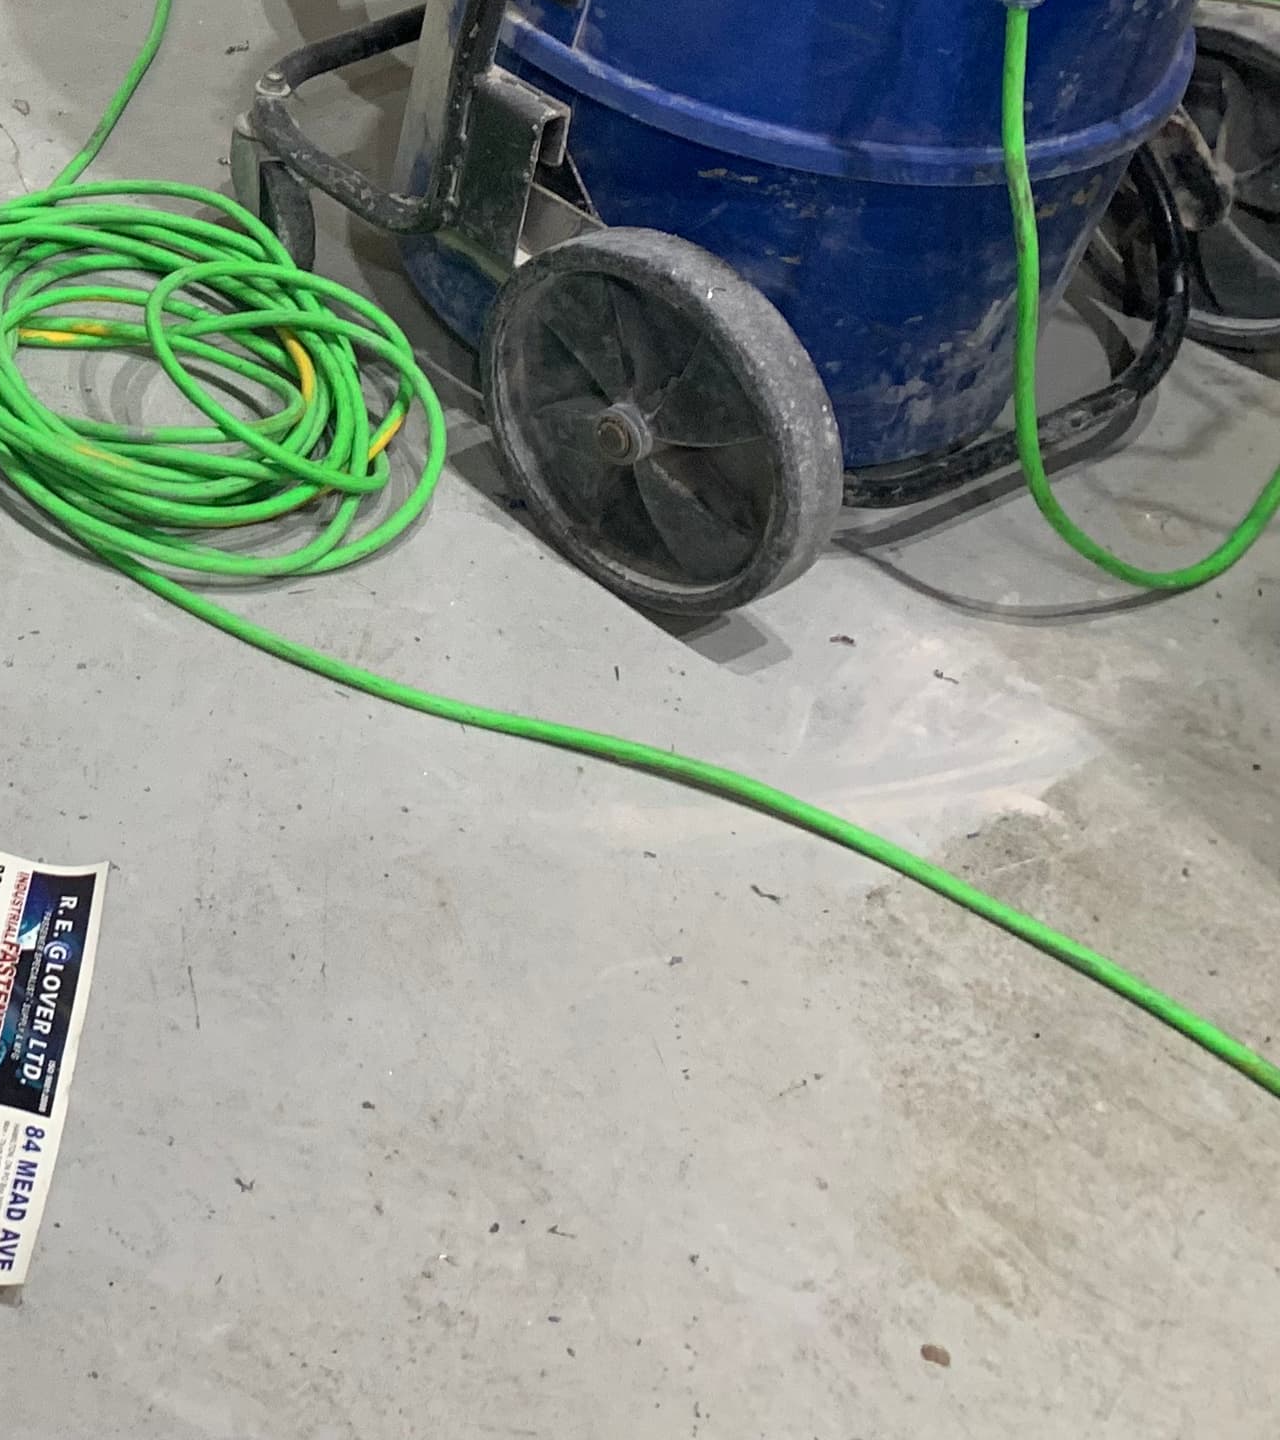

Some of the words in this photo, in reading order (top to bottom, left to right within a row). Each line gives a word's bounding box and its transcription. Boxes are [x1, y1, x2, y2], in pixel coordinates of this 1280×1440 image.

[30, 941, 67, 1035] GLOVER
[19, 1037, 48, 1089] LTD.
[22, 1125, 44, 1152] 84
[6, 1160, 36, 1220] MEAD
